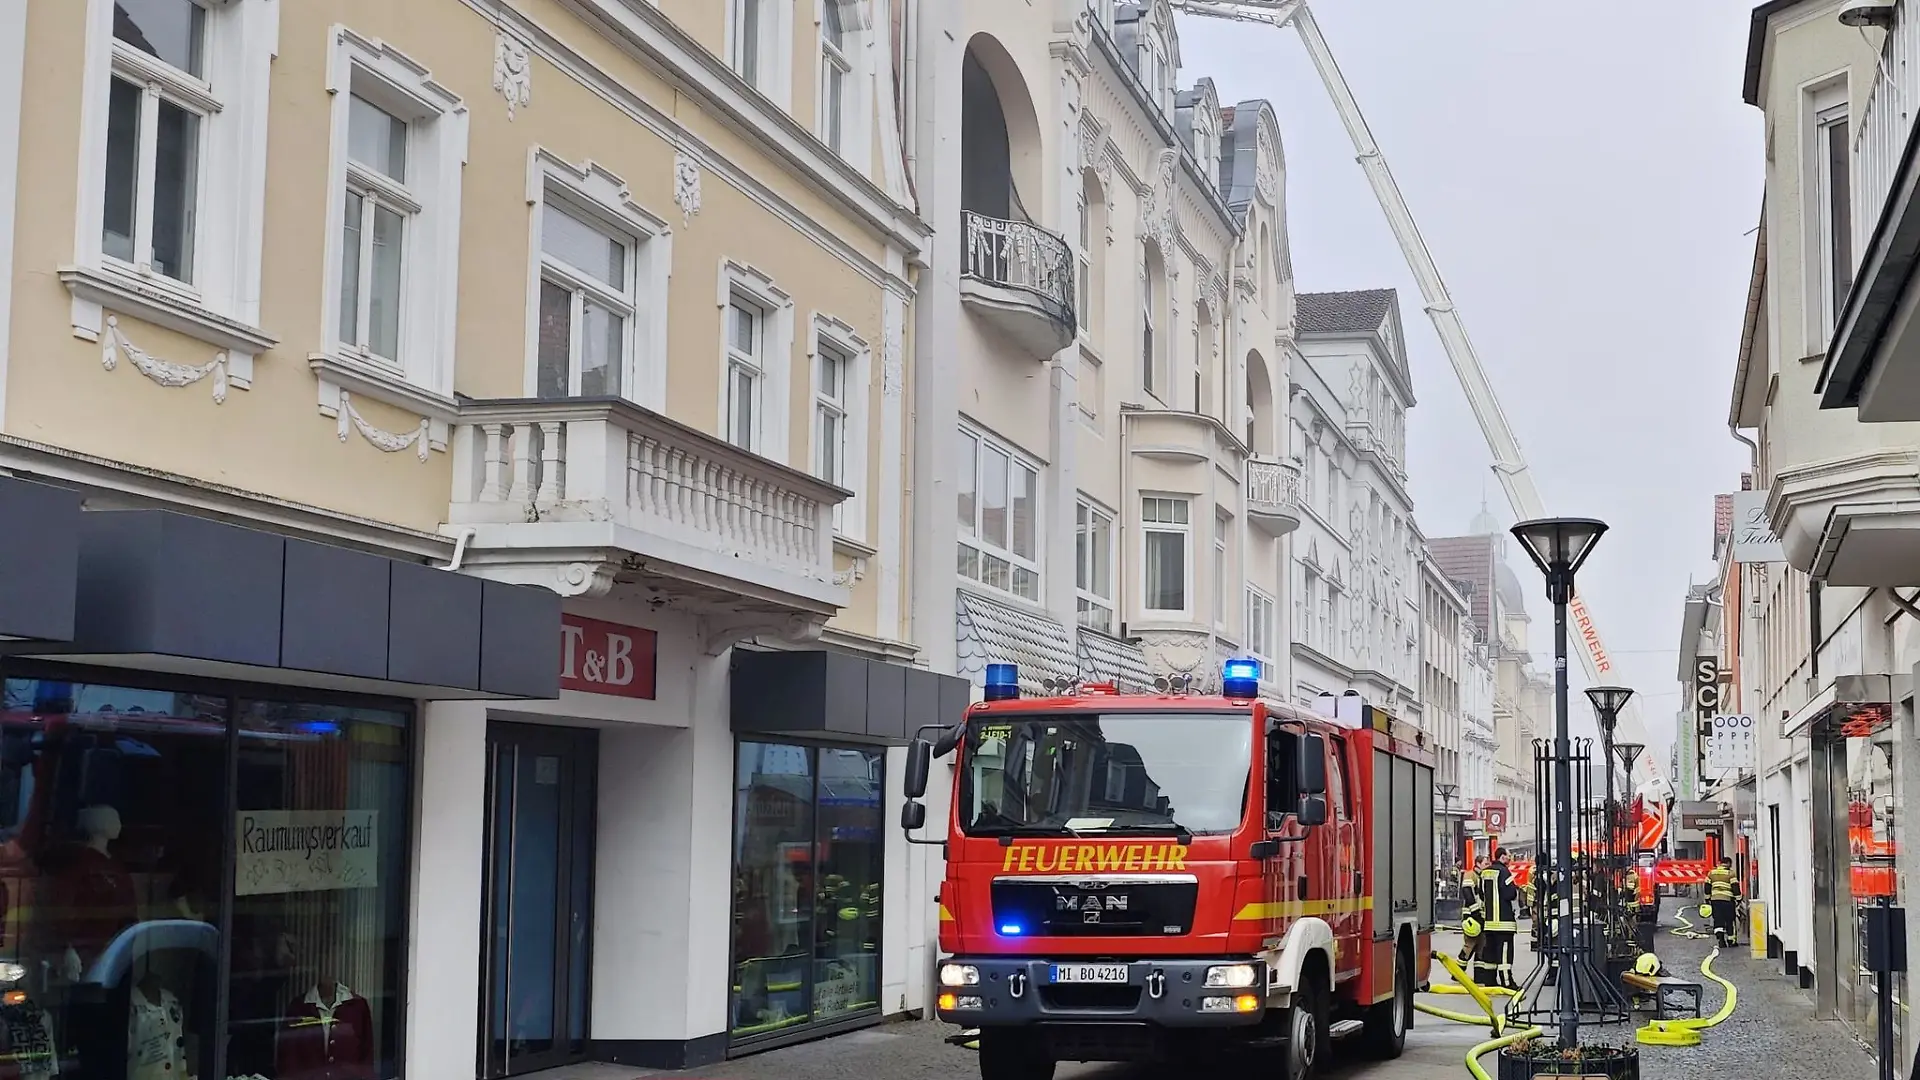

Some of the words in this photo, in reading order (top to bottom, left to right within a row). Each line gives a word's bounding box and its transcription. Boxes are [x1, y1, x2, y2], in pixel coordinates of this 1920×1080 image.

[1569, 594, 1610, 673] UERWEHR
[1002, 844, 1188, 872] FEUERWEHR
[1056, 895, 1128, 911] MAN
[1058, 965, 1071, 980] MI
[1080, 964, 1095, 980] BO
[1097, 964, 1125, 980] 4216
